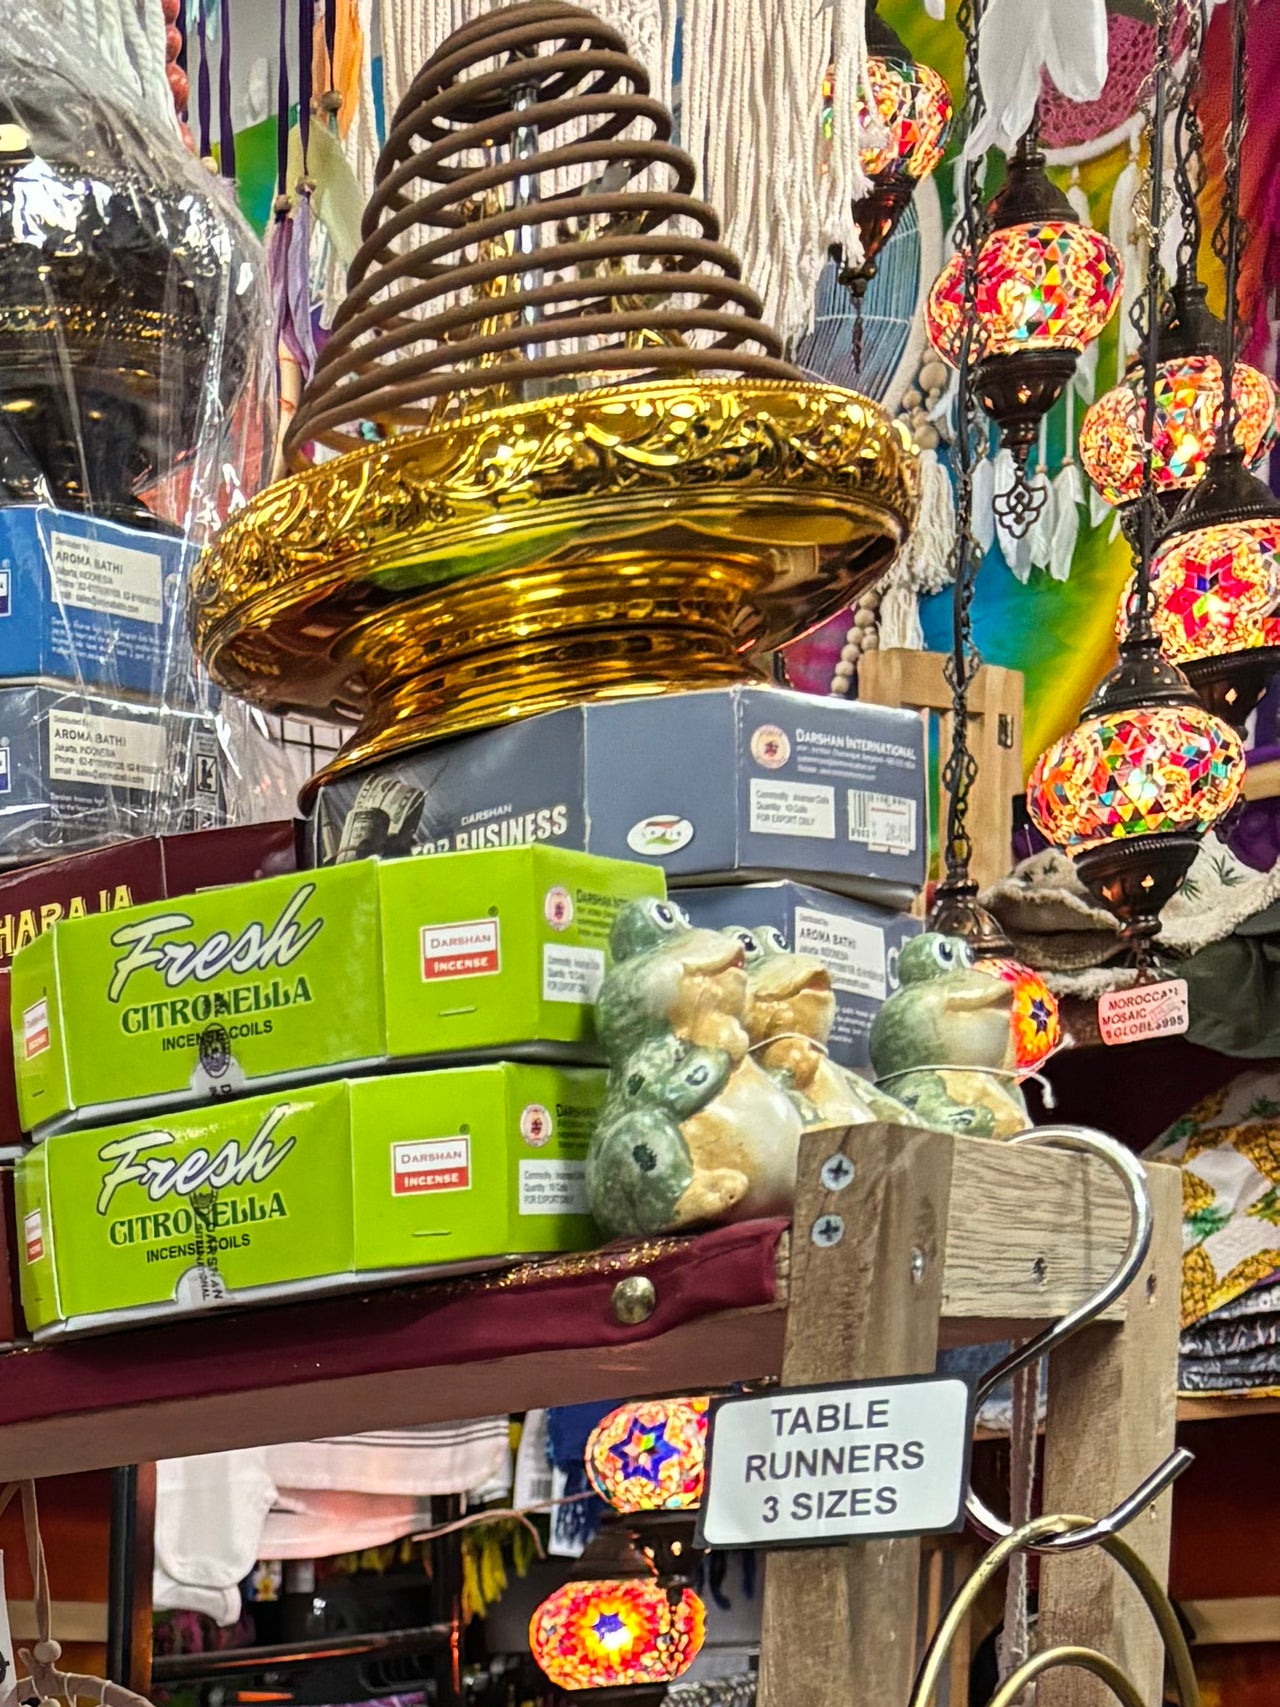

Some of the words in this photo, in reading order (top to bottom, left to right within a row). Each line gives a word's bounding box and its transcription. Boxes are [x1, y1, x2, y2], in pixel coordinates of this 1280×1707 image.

[55, 551, 91, 568] AROMA
[54, 729, 91, 744] AROMA
[796, 728, 845, 748] DARSHAN
[846, 735, 918, 760] INTERNATIONAL
[461, 804, 512, 826] DARSHAN
[107, 883, 323, 1003] Fresh
[430, 933, 492, 950] DARSHAN
[433, 957, 489, 973] INCENSE
[121, 976, 313, 1034] CITRONELLA
[1102, 1008, 1147, 1025] MOSAIC
[229, 1020, 273, 1040] COILS
[96, 1103, 298, 1216] Fresh
[401, 1149, 462, 1165] DARSHAN
[404, 1172, 459, 1188] INCENSE
[771, 1399, 891, 1437] TABLE
[745, 1442, 925, 1483] RUNNERS
[762, 1495, 779, 1524] 3
[789, 1486, 898, 1521] SIZES
